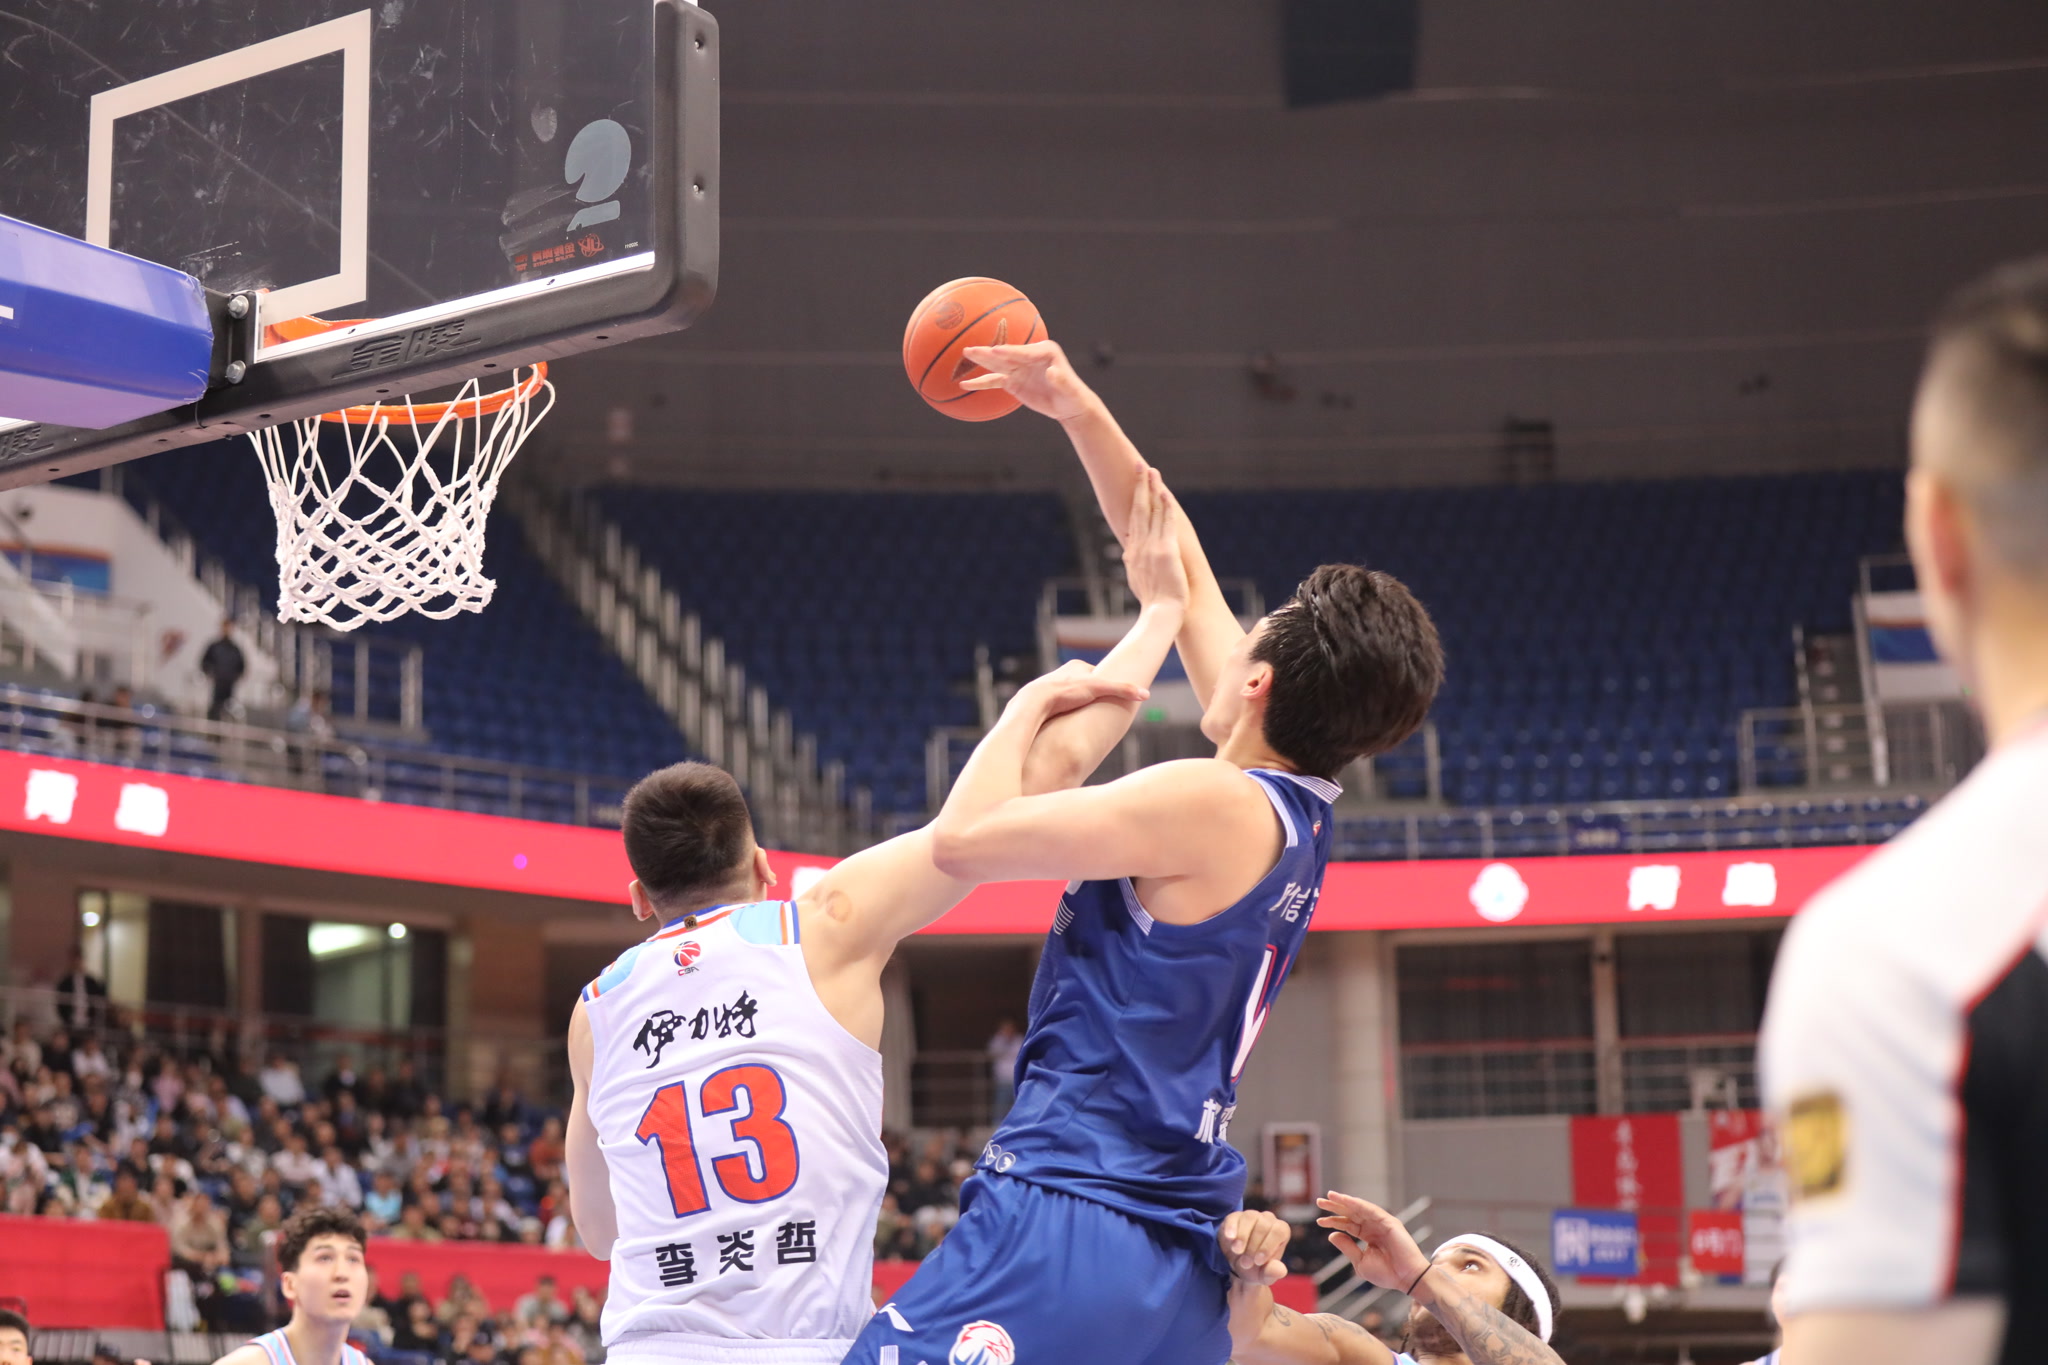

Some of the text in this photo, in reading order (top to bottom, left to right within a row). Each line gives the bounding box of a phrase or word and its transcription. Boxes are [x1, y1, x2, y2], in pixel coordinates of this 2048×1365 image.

[677, 966, 700, 976] CBA
[635, 1063, 800, 1218] 13
[655, 1220, 816, 1287] 李炎哲
